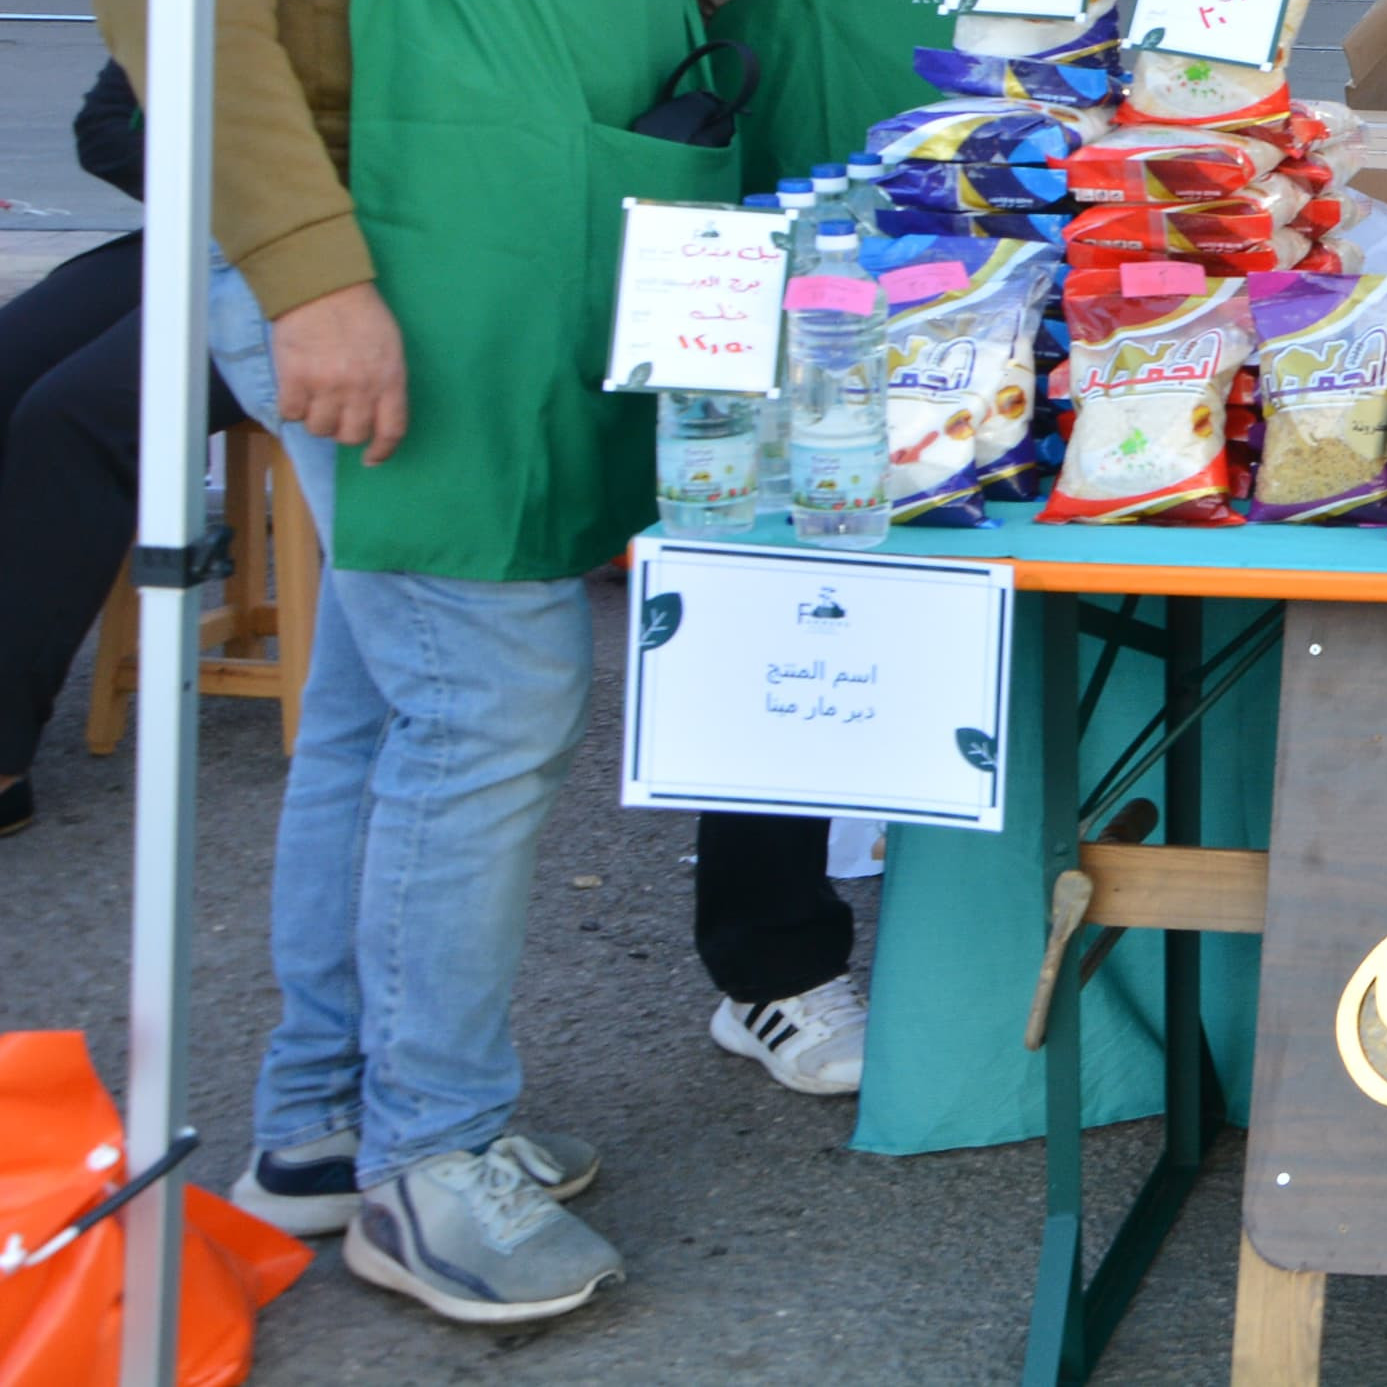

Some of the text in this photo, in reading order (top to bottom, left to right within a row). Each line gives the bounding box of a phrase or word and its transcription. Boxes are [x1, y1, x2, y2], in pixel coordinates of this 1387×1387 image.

[765, 661, 878, 688] اسم المنتج
[765, 692, 877, 724] دير مار مينا
